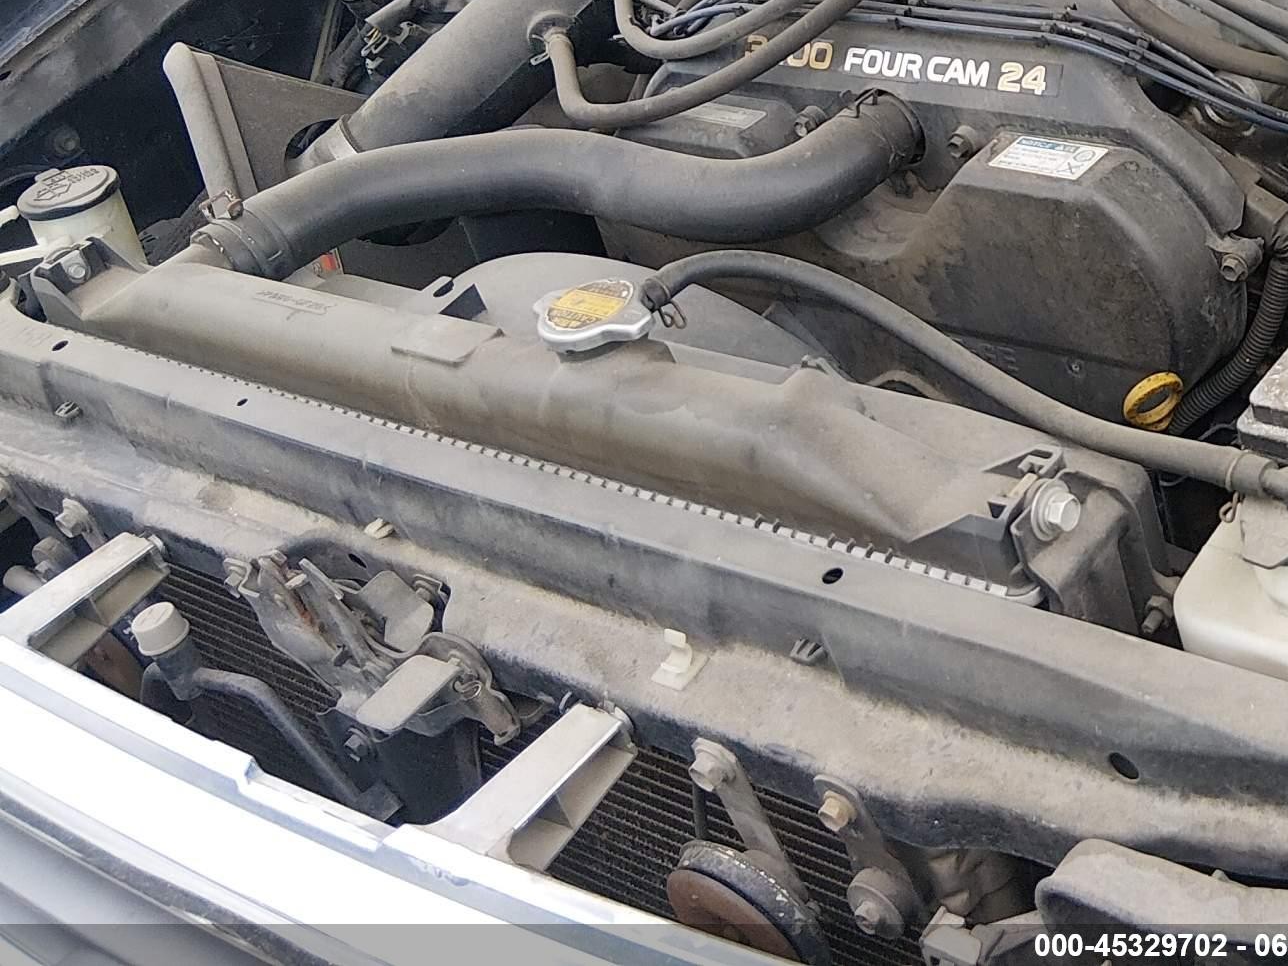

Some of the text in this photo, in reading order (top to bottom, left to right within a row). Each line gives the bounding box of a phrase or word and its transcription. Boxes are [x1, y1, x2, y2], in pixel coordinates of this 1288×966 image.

[745, 34, 1047, 96] 300 FOUR CAM 24
